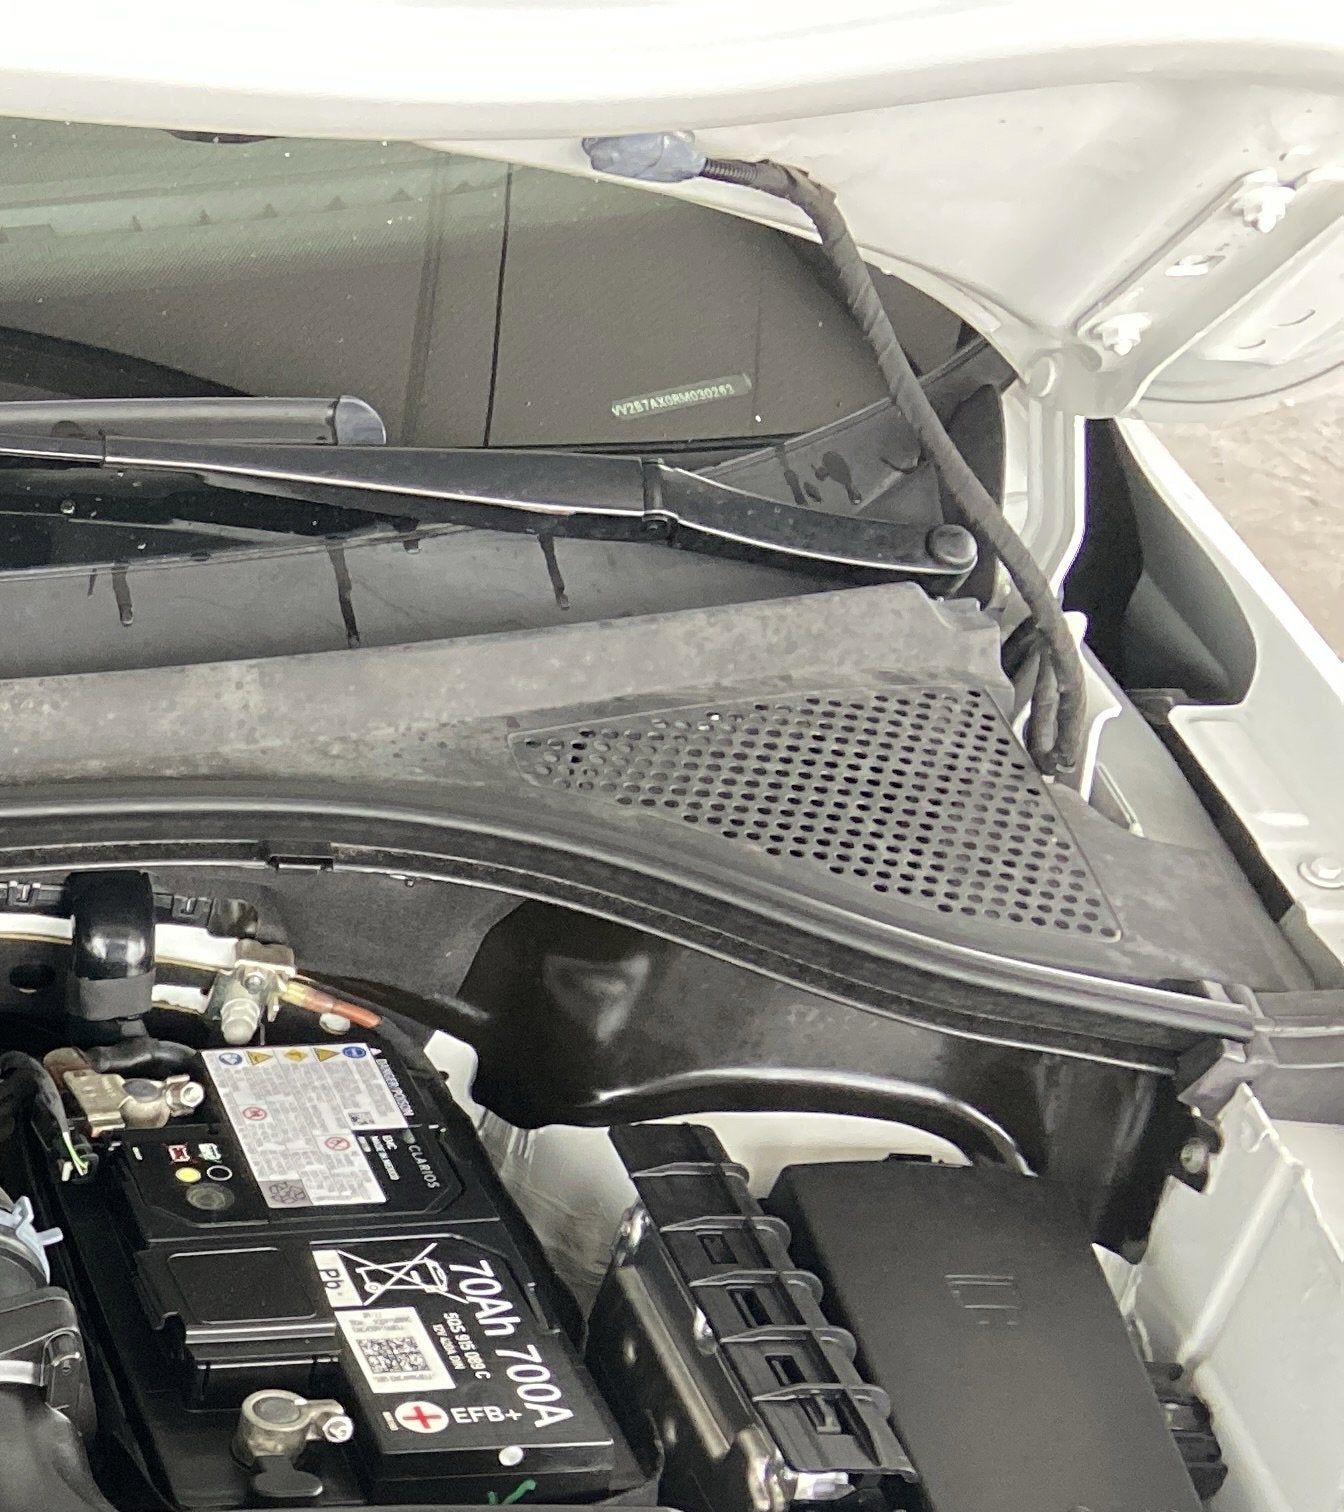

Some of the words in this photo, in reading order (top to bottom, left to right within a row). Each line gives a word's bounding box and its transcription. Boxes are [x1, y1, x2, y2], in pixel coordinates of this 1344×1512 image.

[408, 1144, 440, 1189] CLARIOS
[320, 1268, 342, 1290] Pb
[449, 1259, 521, 1337] 70Ah
[496, 1344, 575, 1428] 700A
[475, 1367, 492, 1381] C
[450, 1405, 522, 1425] EFB+
